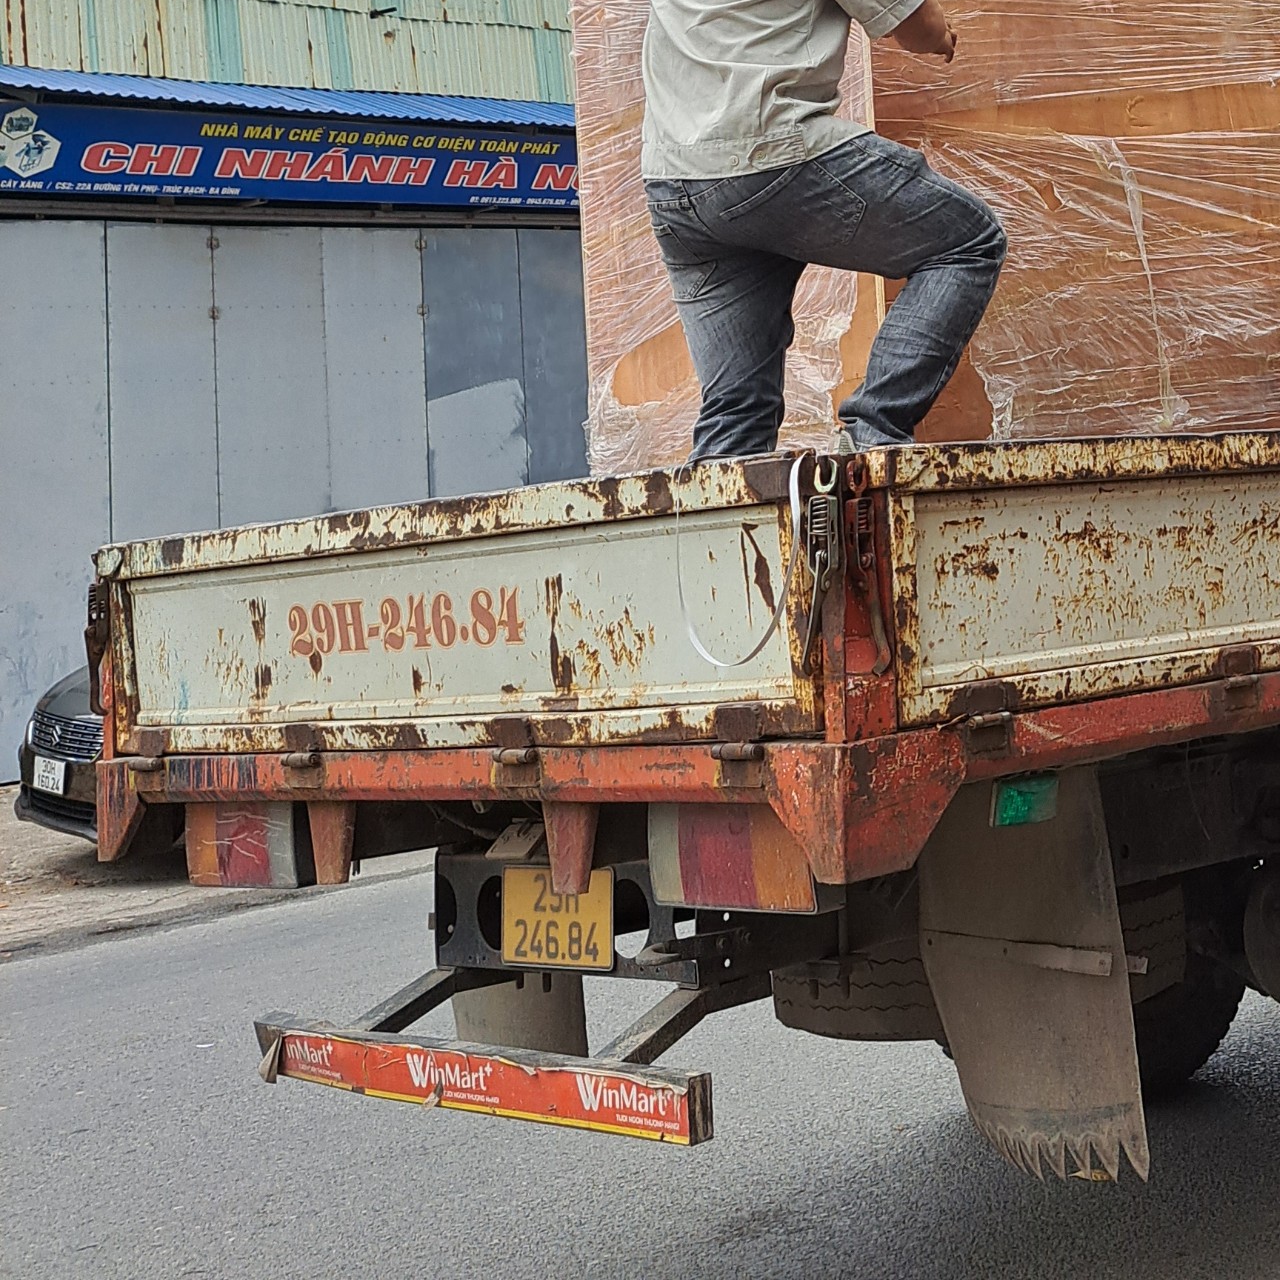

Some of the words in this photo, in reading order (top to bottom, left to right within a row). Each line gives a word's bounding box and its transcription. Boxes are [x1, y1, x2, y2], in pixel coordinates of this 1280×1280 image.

[200, 122, 239, 138] NHÀ
[244, 124, 285, 140] MÁY
[288, 125, 326, 142] CHẾ
[328, 130, 360, 146] TẠO
[363, 131, 409, 148] ĐỘNG
[412, 134, 437, 149] CƠ
[437, 136, 476, 153] ĐIỆN
[479, 139, 519, 153] TOÀN
[521, 140, 561, 156] PHÁT
[80, 141, 203, 177] CHI
[214, 147, 436, 187] NHÁNH
[443, 157, 518, 189] HÀ
[531, 163, 579, 192] N
[288, 585, 526, 658] 29H-246.84
[514, 919, 599, 961] 246.84
